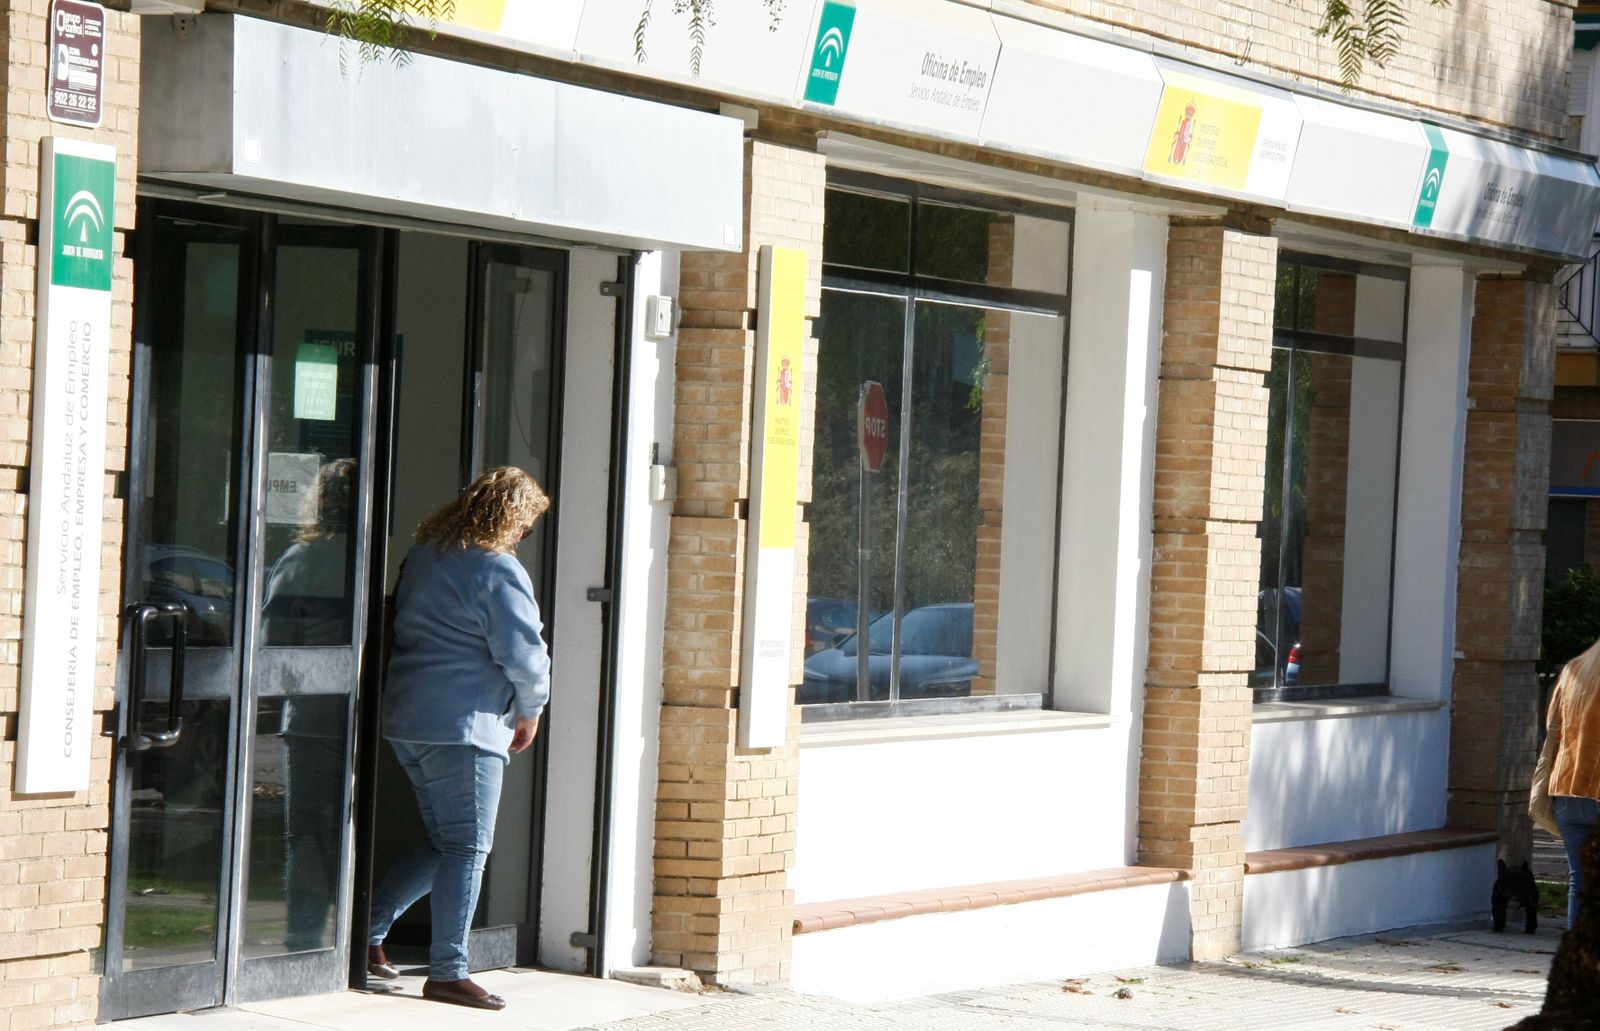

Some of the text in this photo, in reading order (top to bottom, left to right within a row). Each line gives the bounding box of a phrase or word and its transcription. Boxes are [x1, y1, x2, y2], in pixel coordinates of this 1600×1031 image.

[908, 82, 931, 101] Servicio
[921, 51, 987, 92] Oficina de Empleo
[54, 91, 96, 110] 902 26 22 22
[80, 322, 91, 421] COMERCIO
[79, 426, 87, 436] Y
[56, 320, 78, 595] Servicio Andaluz de Empleo
[75, 442, 87, 526] EMPRESA
[69, 616, 79, 641] DE
[63, 645, 78, 759] CONSEJERÍA
